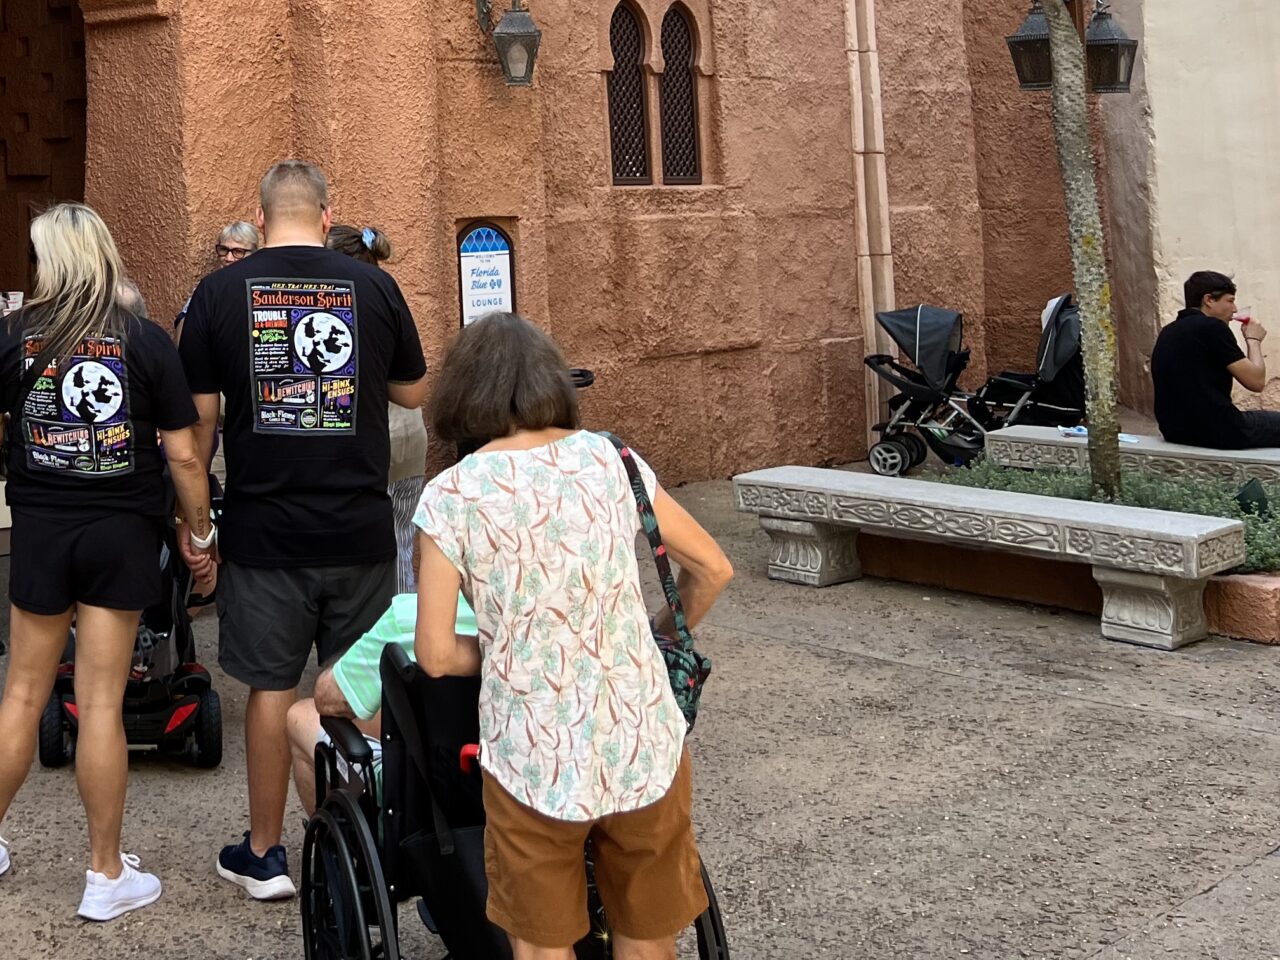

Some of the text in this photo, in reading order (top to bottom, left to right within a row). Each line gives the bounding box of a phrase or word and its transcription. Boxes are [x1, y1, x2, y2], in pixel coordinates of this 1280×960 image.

[471, 266, 500, 277] Florida
[471, 280, 488, 290] Blue
[252, 290, 352, 308] Sanderson Spirit
[472, 298, 503, 307] LOUNGE
[253, 310, 288, 322] TROUBLE
[328, 386, 355, 399] ENSUES
[47, 429, 89, 444] BEWITCHING
[103, 430, 130, 446] ENSUES
